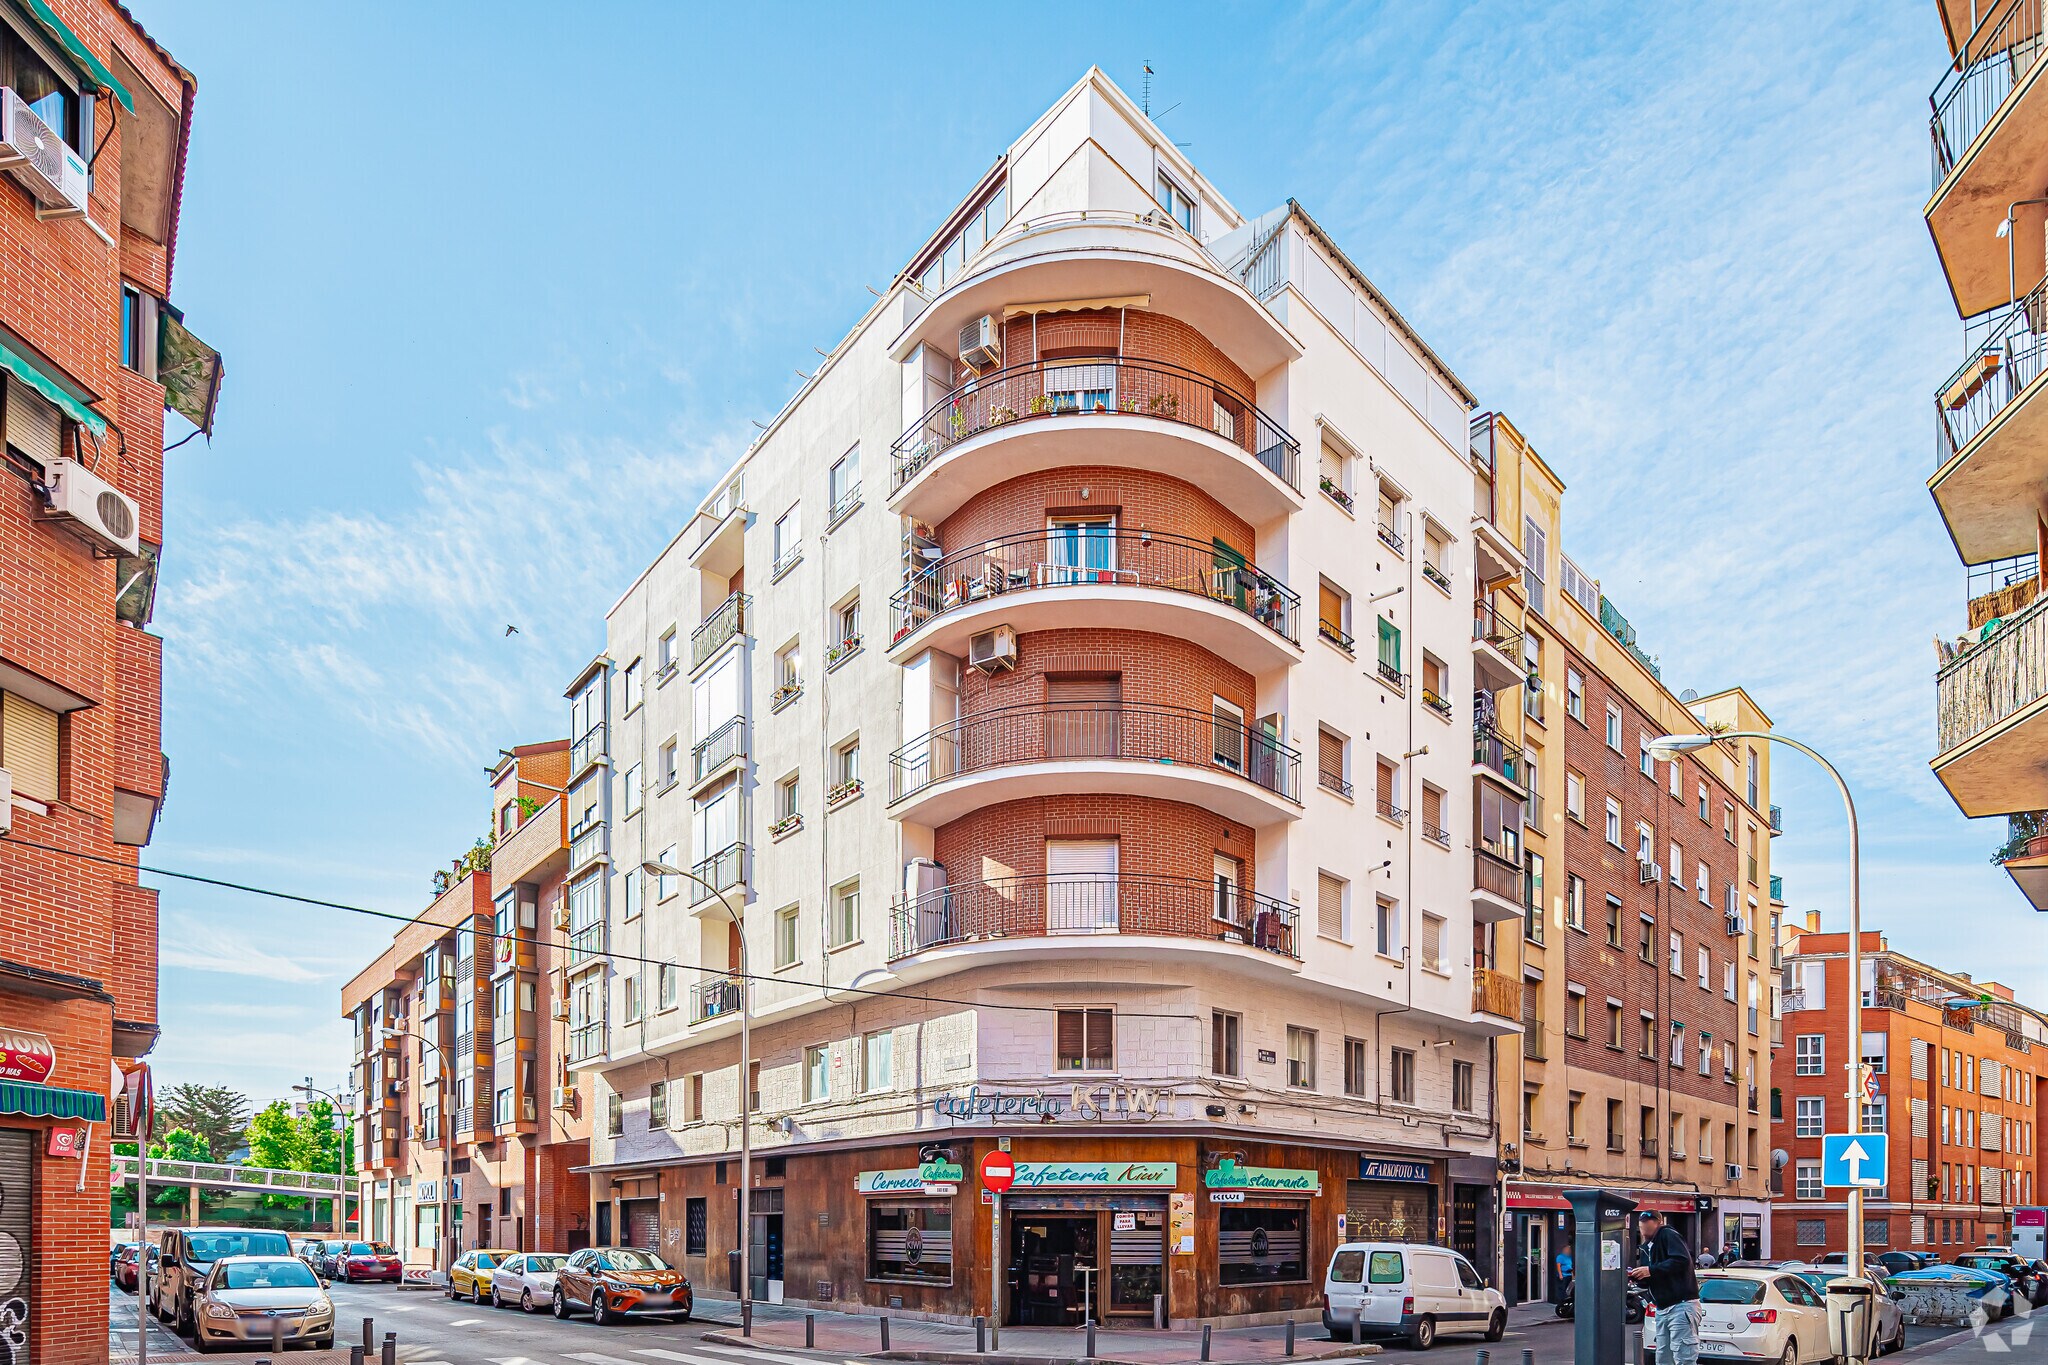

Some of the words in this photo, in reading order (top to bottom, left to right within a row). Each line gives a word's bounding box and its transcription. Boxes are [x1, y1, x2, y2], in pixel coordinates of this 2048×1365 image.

[5, 1068, 22, 1077] MAS
[1071, 1085, 1176, 1118] KIWI
[1117, 1164, 1168, 1182] Kiwi
[1377, 1163, 1413, 1178] ARKOFOTO
[1252, 1241, 1267, 1251] KIWI
[1706, 1343, 1724, 1352] GVC
